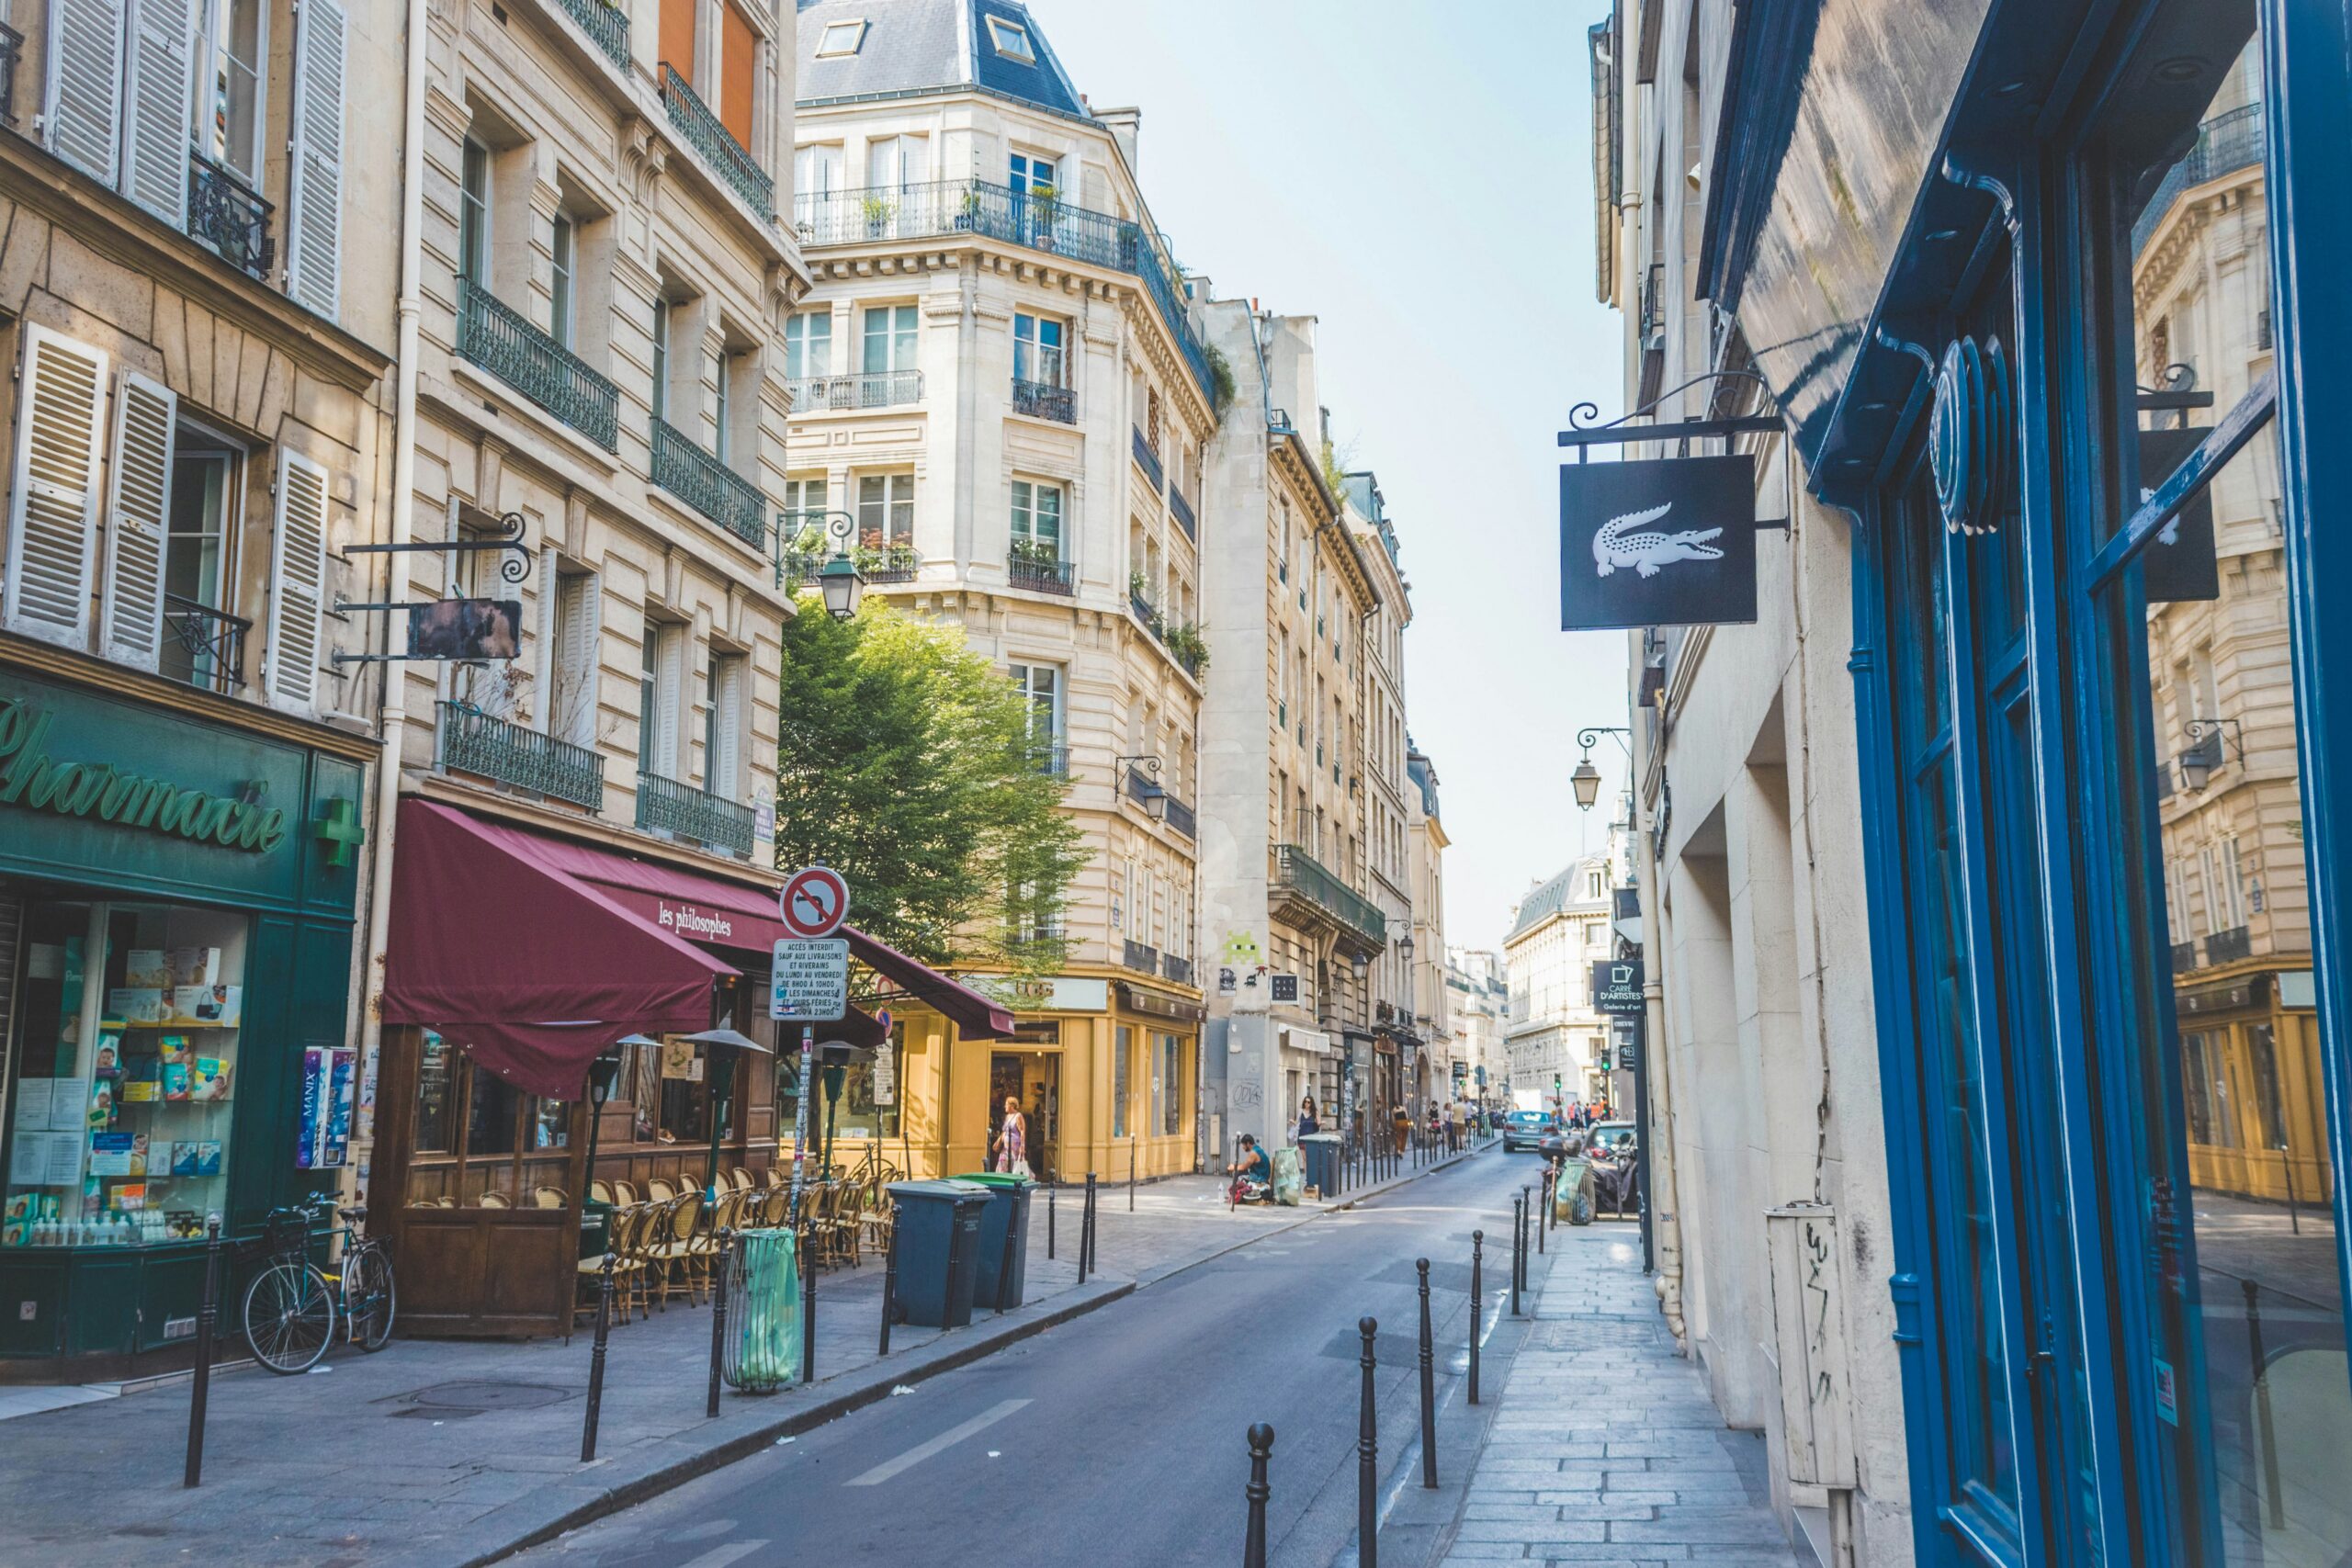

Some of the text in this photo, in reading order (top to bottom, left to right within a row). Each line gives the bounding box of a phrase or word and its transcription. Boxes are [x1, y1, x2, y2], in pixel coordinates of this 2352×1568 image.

[0, 695, 285, 852] Pharmacie
[659, 900, 731, 941] les philosophes
[789, 989, 800, 998] LES
[802, 989, 835, 998] DIMANCHES
[1609, 984, 1632, 993] CARRÉ
[793, 998, 810, 1007] JOURS
[303, 1072, 316, 1117] MANIX
